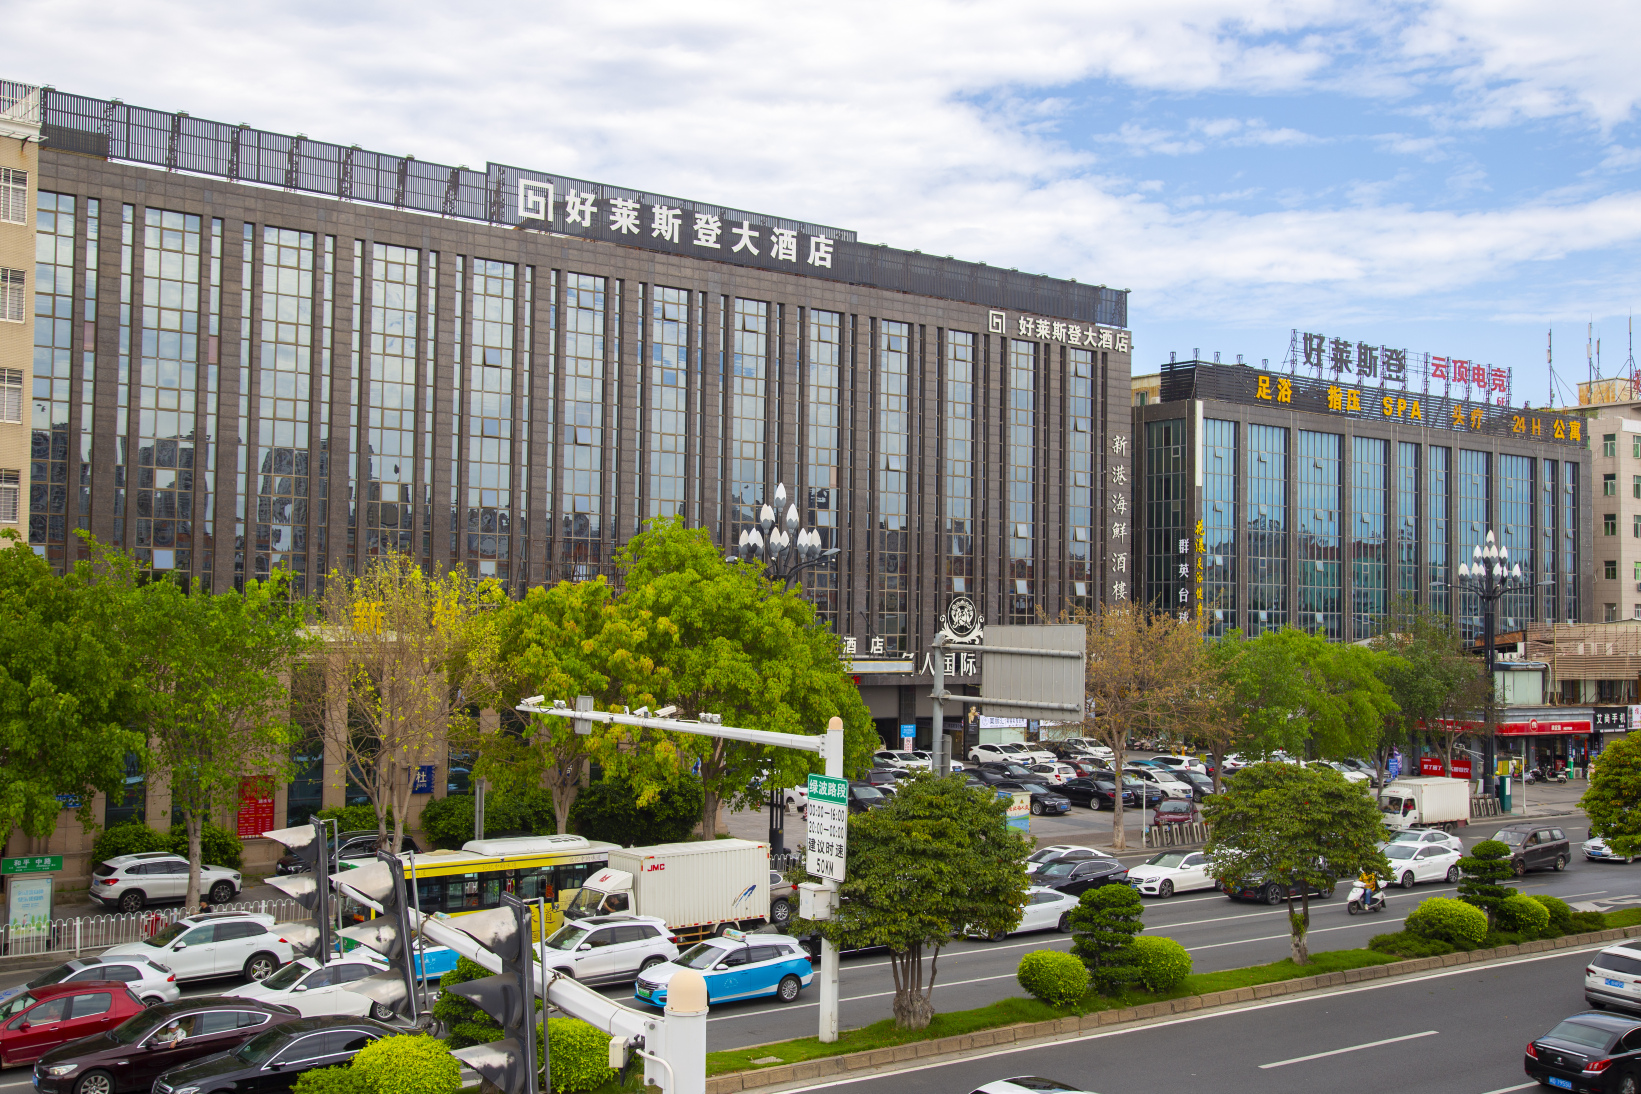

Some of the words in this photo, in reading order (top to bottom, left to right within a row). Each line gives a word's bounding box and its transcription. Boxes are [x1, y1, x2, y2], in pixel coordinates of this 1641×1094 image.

[565, 188, 835, 269] 好莱斯登大酒店
[1017, 315, 1130, 354] 好莱斯登大酒店
[1302, 331, 1406, 381] 好莱斯登
[1431, 355, 1508, 392] 云顶电竞
[1255, 375, 1293, 405] 足浴
[1327, 385, 1362, 412] 指压
[1382, 396, 1422, 421] SPA
[1451, 403, 1484, 430] 头疗
[1553, 418, 1582, 442] 公寓
[1178, 538, 1190, 624] 群英台球
[1194, 518, 1207, 646] 花漾足浴健康会
[901, 652, 977, 677] 人国际
[1596, 712, 1626, 725] 艾尚手机
[809, 779, 847, 799] 绿波路段
[808, 837, 844, 859] 建议时速
[647, 863, 666, 872] JMC
